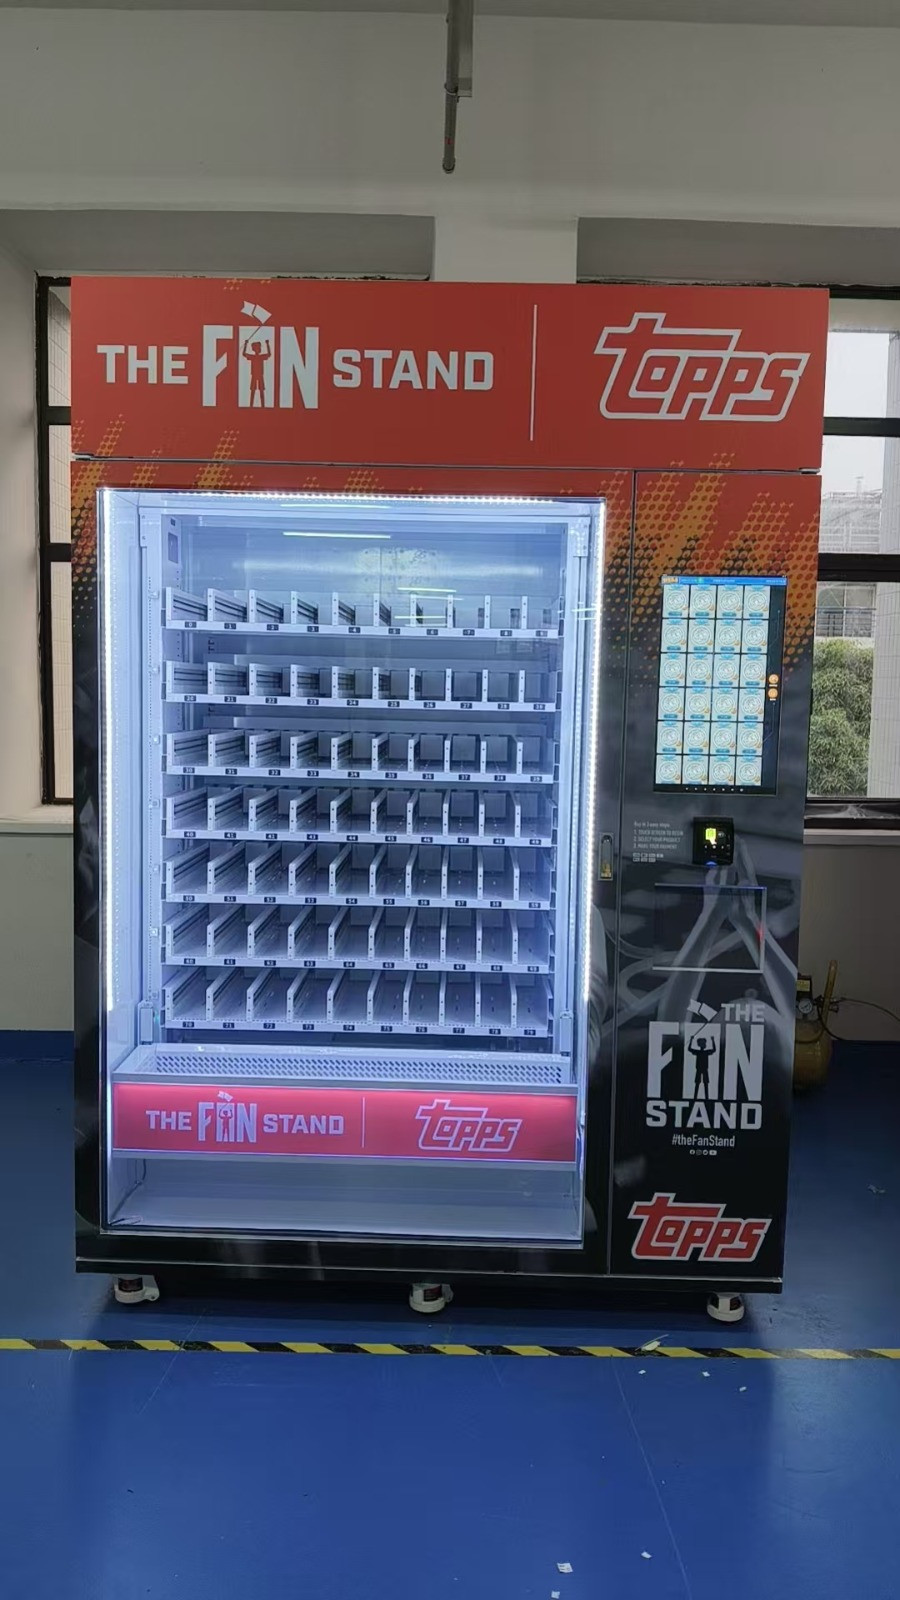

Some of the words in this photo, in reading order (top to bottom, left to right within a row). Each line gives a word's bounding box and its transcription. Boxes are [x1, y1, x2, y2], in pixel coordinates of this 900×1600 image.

[97, 345, 189, 384] THE
[332, 348, 494, 391] STAND
[721, 1002, 765, 1022] THE
[145, 1109, 192, 1130] THE
[263, 1113, 345, 1135] STAND
[646, 1100, 763, 1130] STAND
[672, 1133, 736, 1148] #theFanStand
